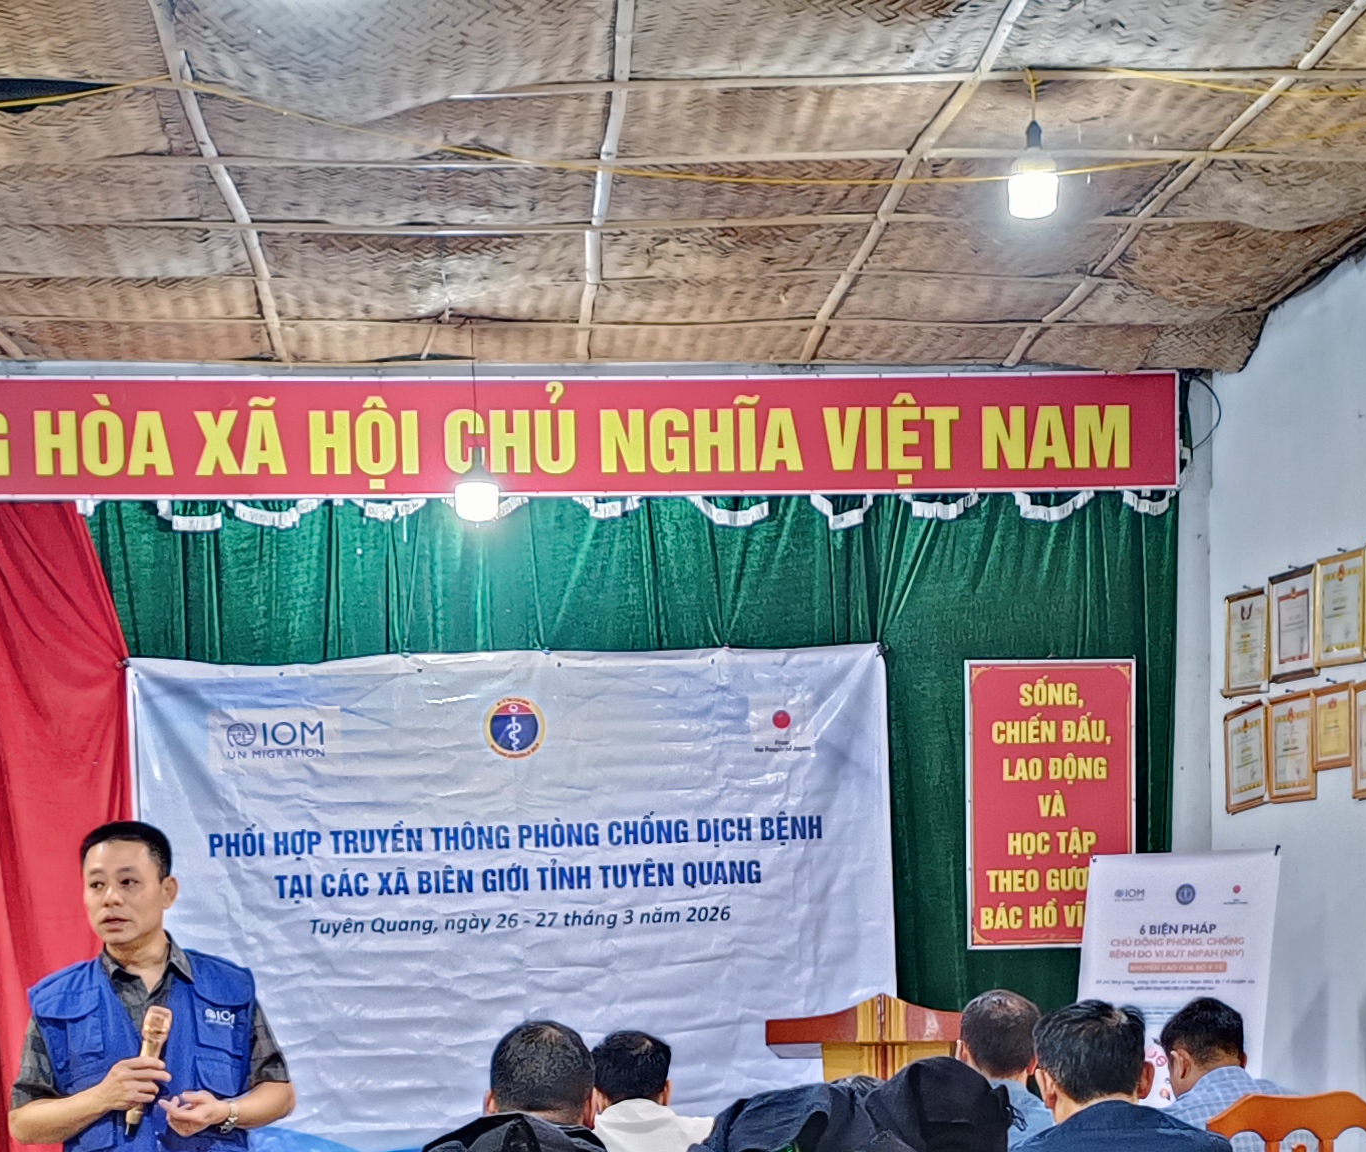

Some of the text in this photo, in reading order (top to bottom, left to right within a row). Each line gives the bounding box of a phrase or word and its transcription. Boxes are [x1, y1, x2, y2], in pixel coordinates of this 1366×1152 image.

[34, 393, 175, 477] HÒA
[194, 398, 288, 477] XÃ
[308, 394, 420, 490] HỘI
[444, 381, 577, 475] CHỦ
[599, 394, 804, 474] NGHĨA
[822, 391, 960, 485] VIỆT
[981, 405, 1131, 470] NAM
[1019, 674, 1085, 708] SỐNG,
[262, 721, 325, 747] IOM
[991, 711, 1112, 745] CHIẾN ĐẤU,
[227, 748, 325, 760] UN MIGRATION
[1002, 752, 1108, 785] LAO ĐỘNG
[1037, 789, 1066, 818] VÀ
[209, 811, 823, 861] PHỐI HỢP TRUYỀN THÔNG PHÒNG CHỐNG DỊCH BỆNH
[1007, 826, 1097, 860] HỌC TẬP
[275, 858, 762, 905] TẠI CÁC XÃ BIÊN GIỚI TỈNH TUYÊN QUANG
[986, 866, 1089, 893] THEO GƯƠ
[1125, 889, 1145, 898] IOM
[310, 917, 365, 938] Tuyên
[371, 917, 438, 935] Quang,
[444, 913, 491, 933] ngày
[496, 913, 519, 929] 26
[535, 912, 558, 927] 27
[564, 909, 618, 929] tháng
[623, 909, 634, 925] 3
[639, 907, 681, 924] năm
[686, 906, 731, 922] 2026
[980, 897, 1084, 931] BÁC HỒ VĨ
[1139, 921, 1217, 937] 6 BIỆN PHÁP
